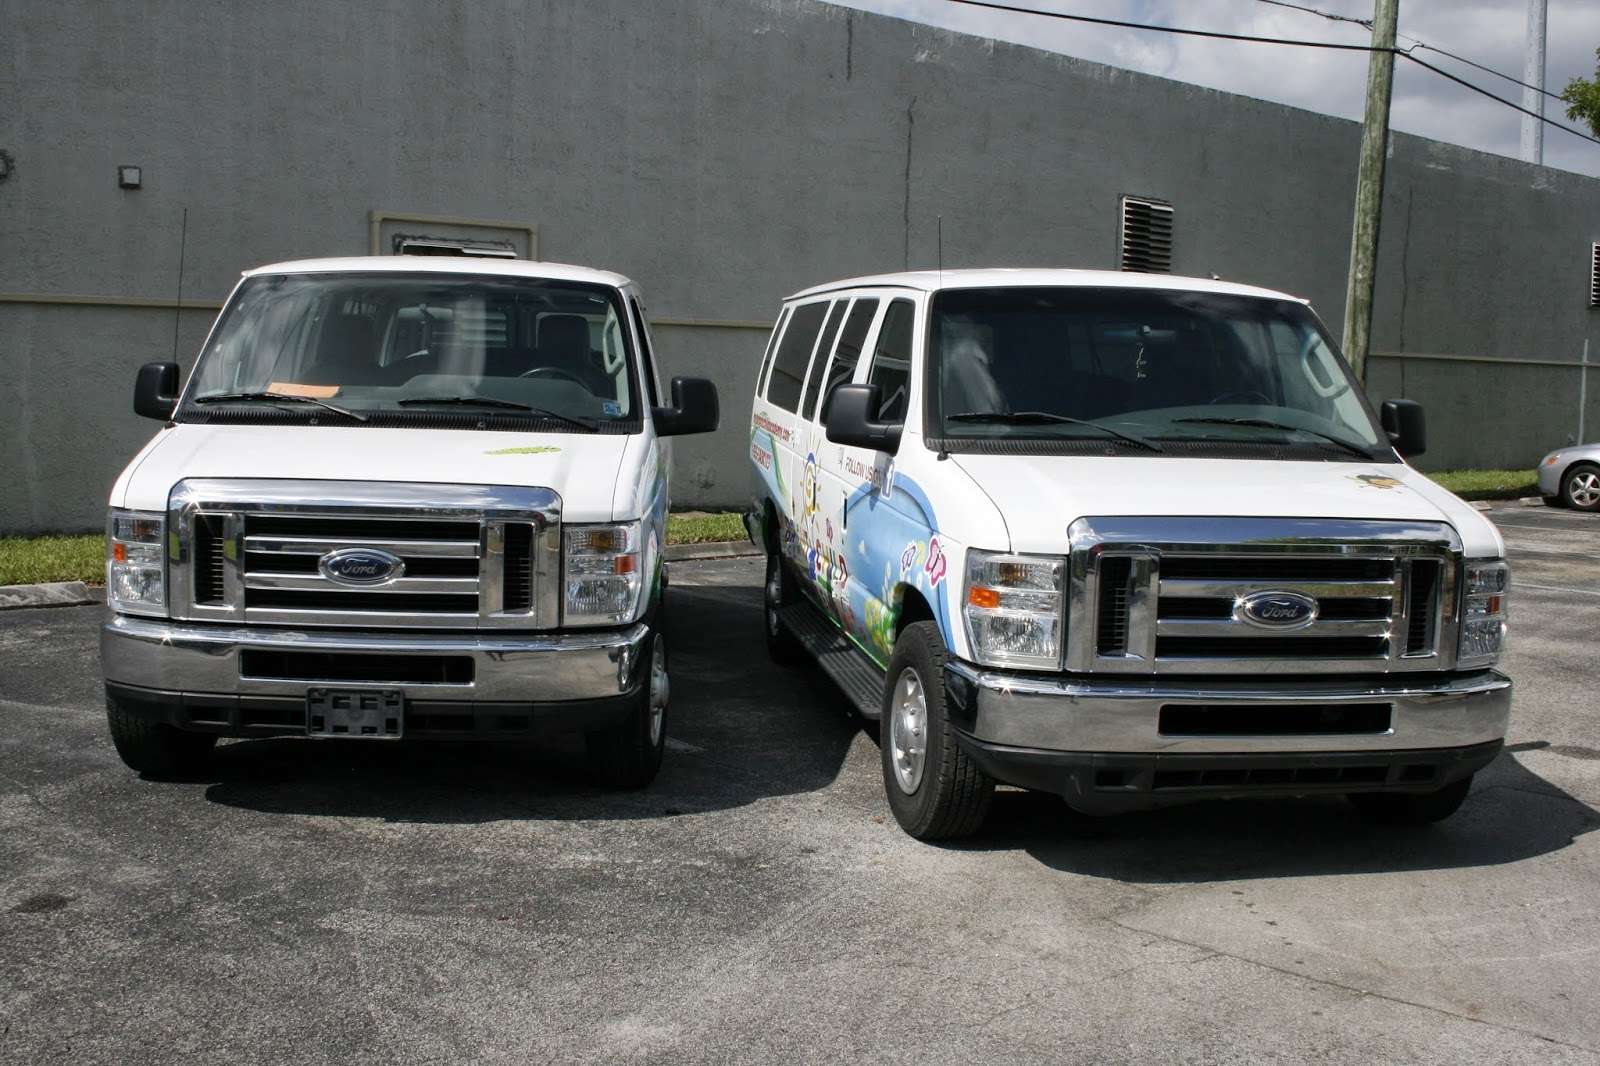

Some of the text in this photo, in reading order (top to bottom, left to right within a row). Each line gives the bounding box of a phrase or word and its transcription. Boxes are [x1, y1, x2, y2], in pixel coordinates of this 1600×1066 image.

[845, 456, 864, 479] FOLLOW
[340, 558, 379, 576] Ford
[1261, 600, 1300, 618] Ford
